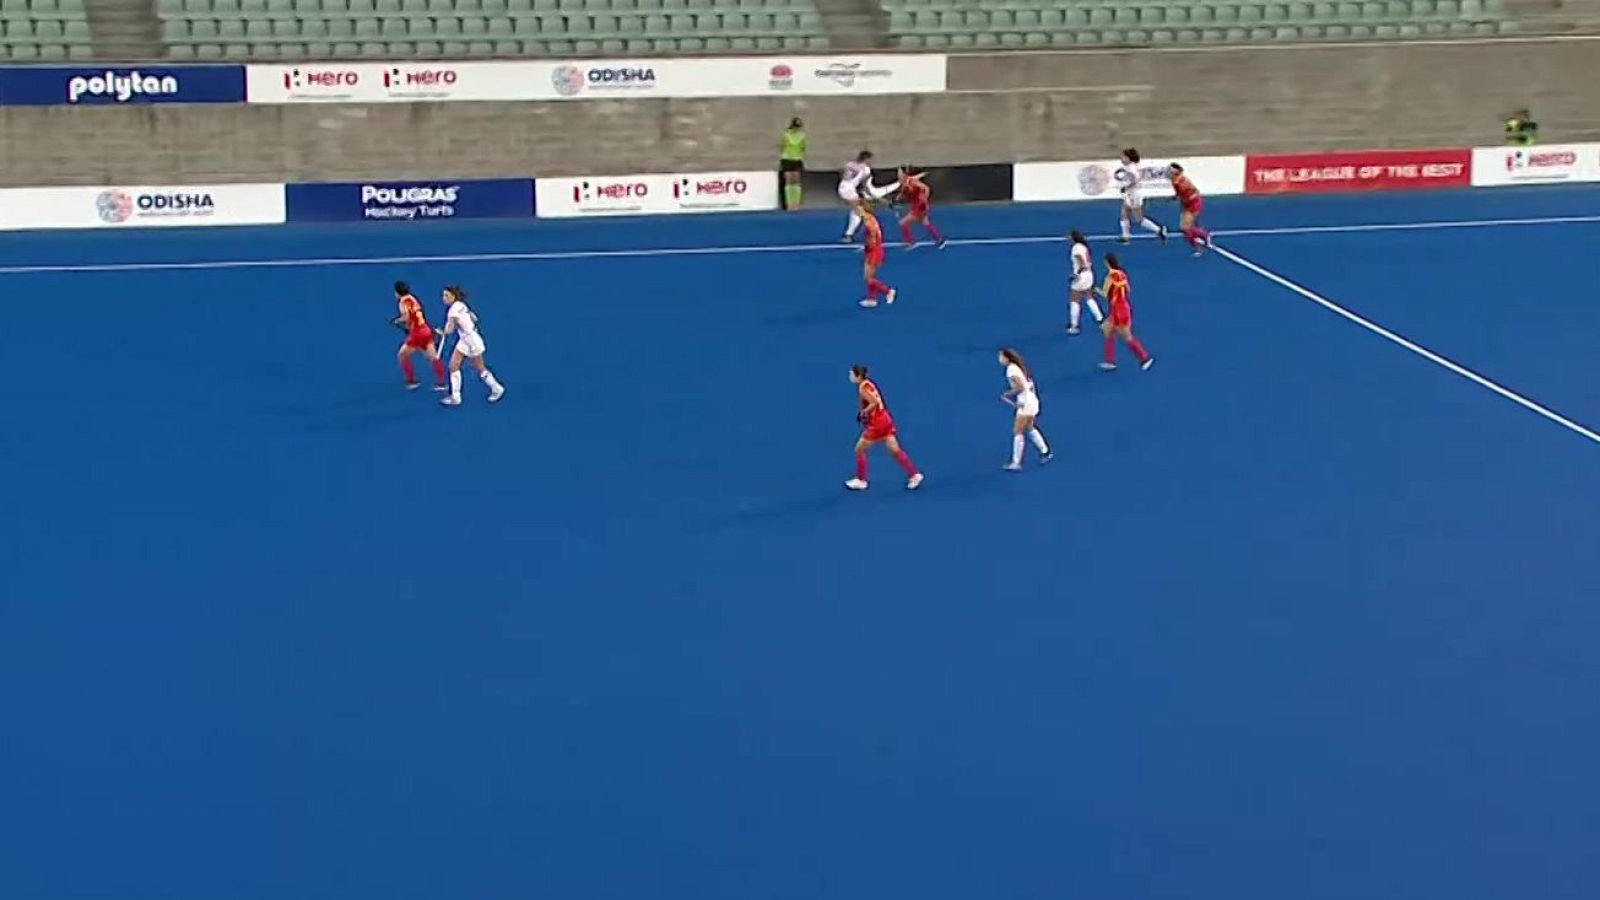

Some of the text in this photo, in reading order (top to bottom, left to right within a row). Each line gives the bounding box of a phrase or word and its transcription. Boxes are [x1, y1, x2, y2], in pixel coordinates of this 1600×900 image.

[588, 68, 655, 82] ODISHA
[69, 71, 177, 102] polytan
[138, 193, 214, 210] ODISHA
